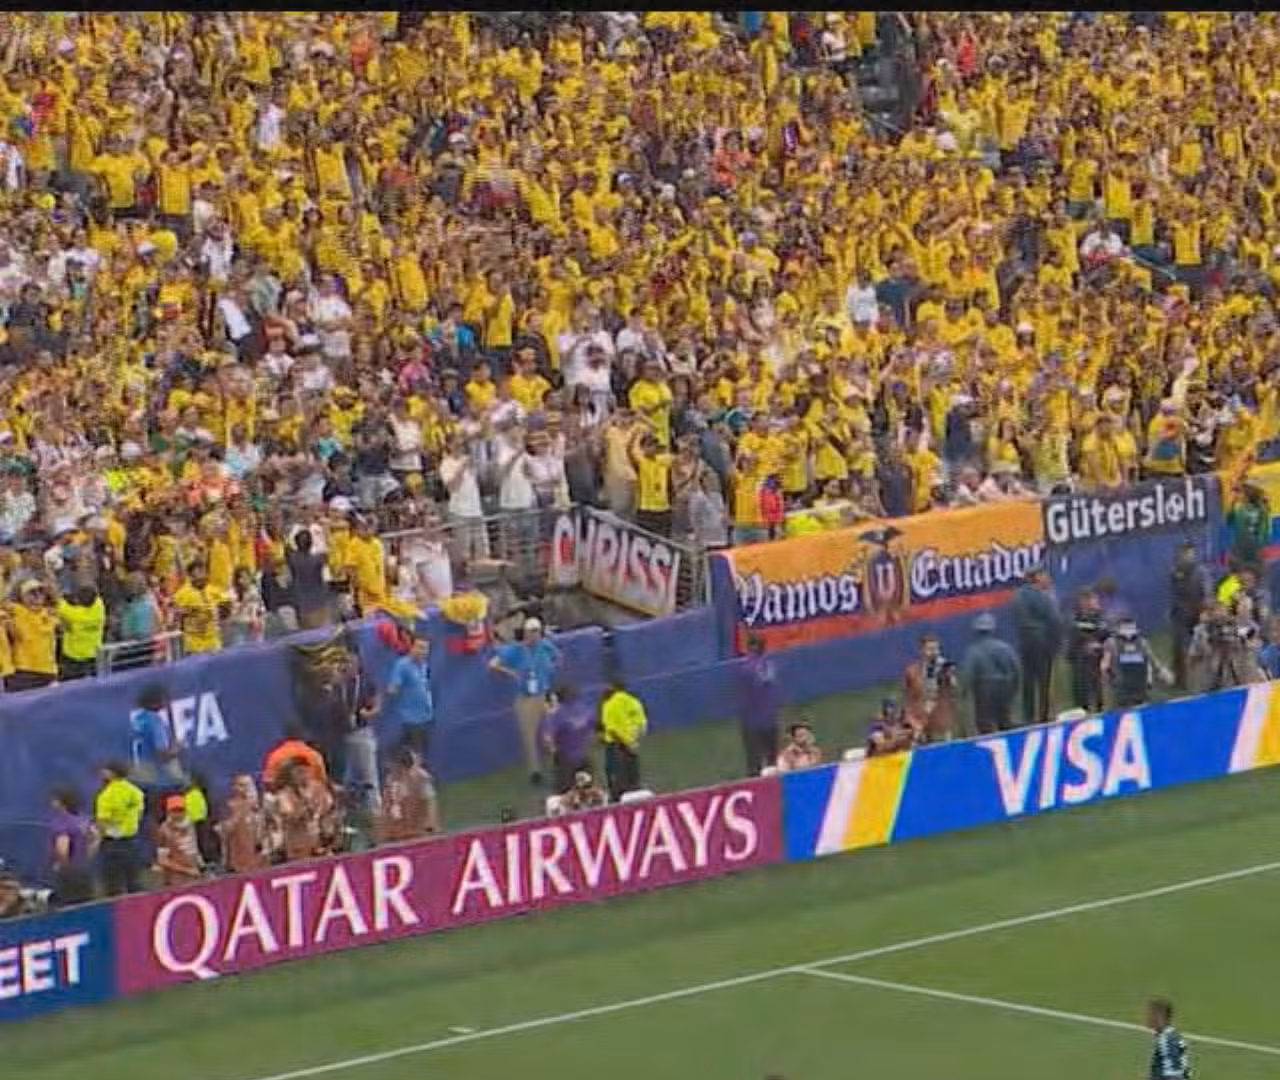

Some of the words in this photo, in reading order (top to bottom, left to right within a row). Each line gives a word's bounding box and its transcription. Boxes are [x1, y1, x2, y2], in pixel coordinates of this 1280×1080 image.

[1046, 479, 1206, 545] Gütersloh
[980, 712, 1152, 816] VISA
[152, 855, 420, 979] QATAR
[451, 789, 759, 916] AIRWAYS
